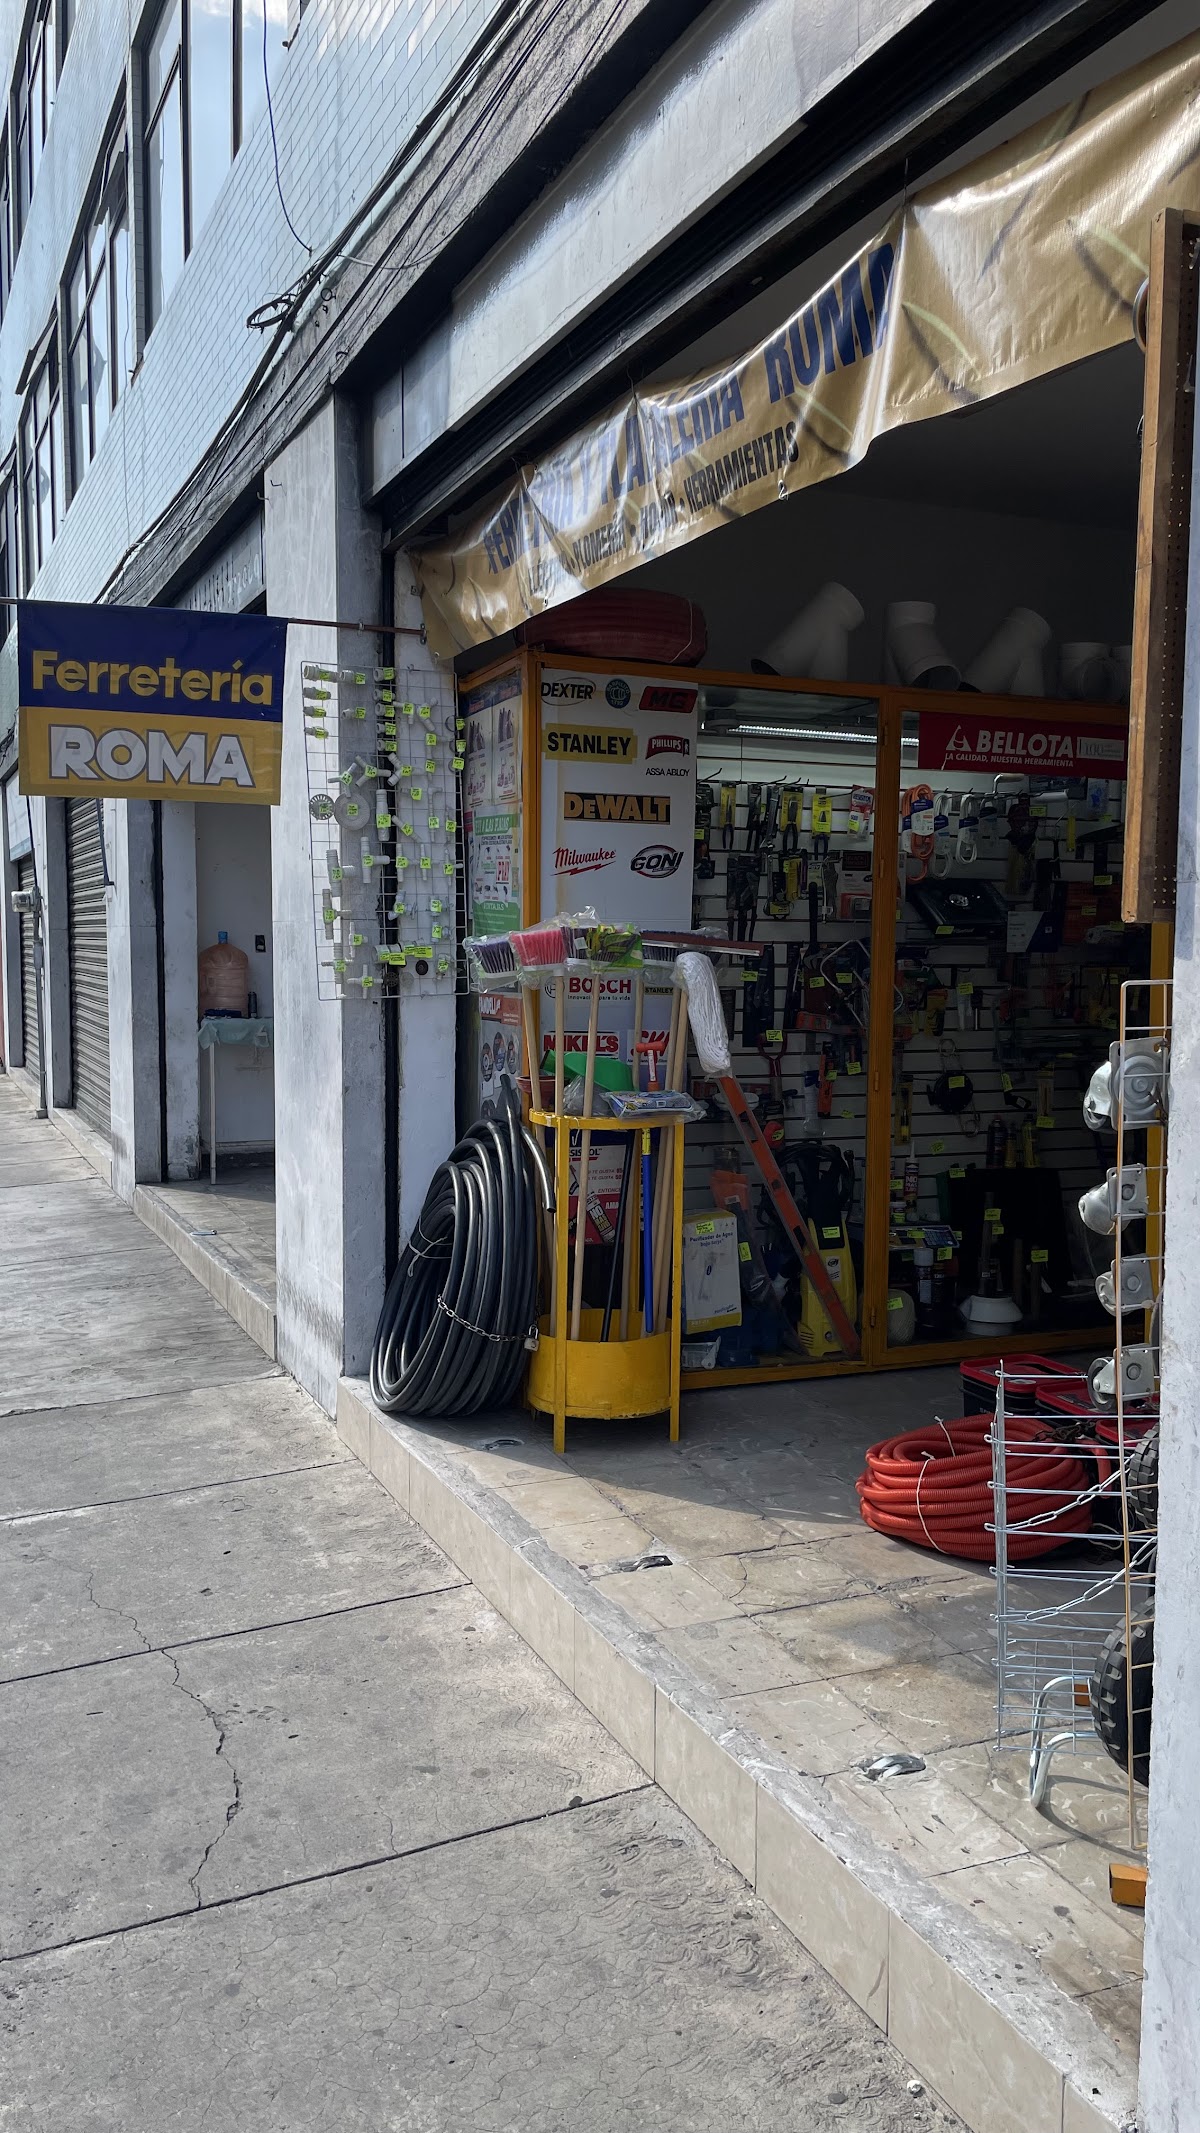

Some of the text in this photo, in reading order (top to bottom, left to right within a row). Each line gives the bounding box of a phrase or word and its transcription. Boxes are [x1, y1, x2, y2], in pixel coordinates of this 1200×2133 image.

[683, 421, 800, 515] HERRAMIENTAS
[32, 650, 273, 706] Ferretería
[541, 682, 594, 700] DEXTER
[547, 732, 631, 756] STANLEY
[652, 738, 682, 750] PHILLIPS
[976, 729, 1074, 758] BELLOTA
[48, 724, 256, 788] ROMA
[991, 755, 1023, 765] NUESTRA
[1024, 757, 1074, 768] HERRAMIENTA
[645, 768, 690, 777] ASSA ABLOY
[553, 846, 616, 868] Milwaukee
[569, 977, 632, 993] BOSCH
[645, 986, 674, 994] STANLEY
